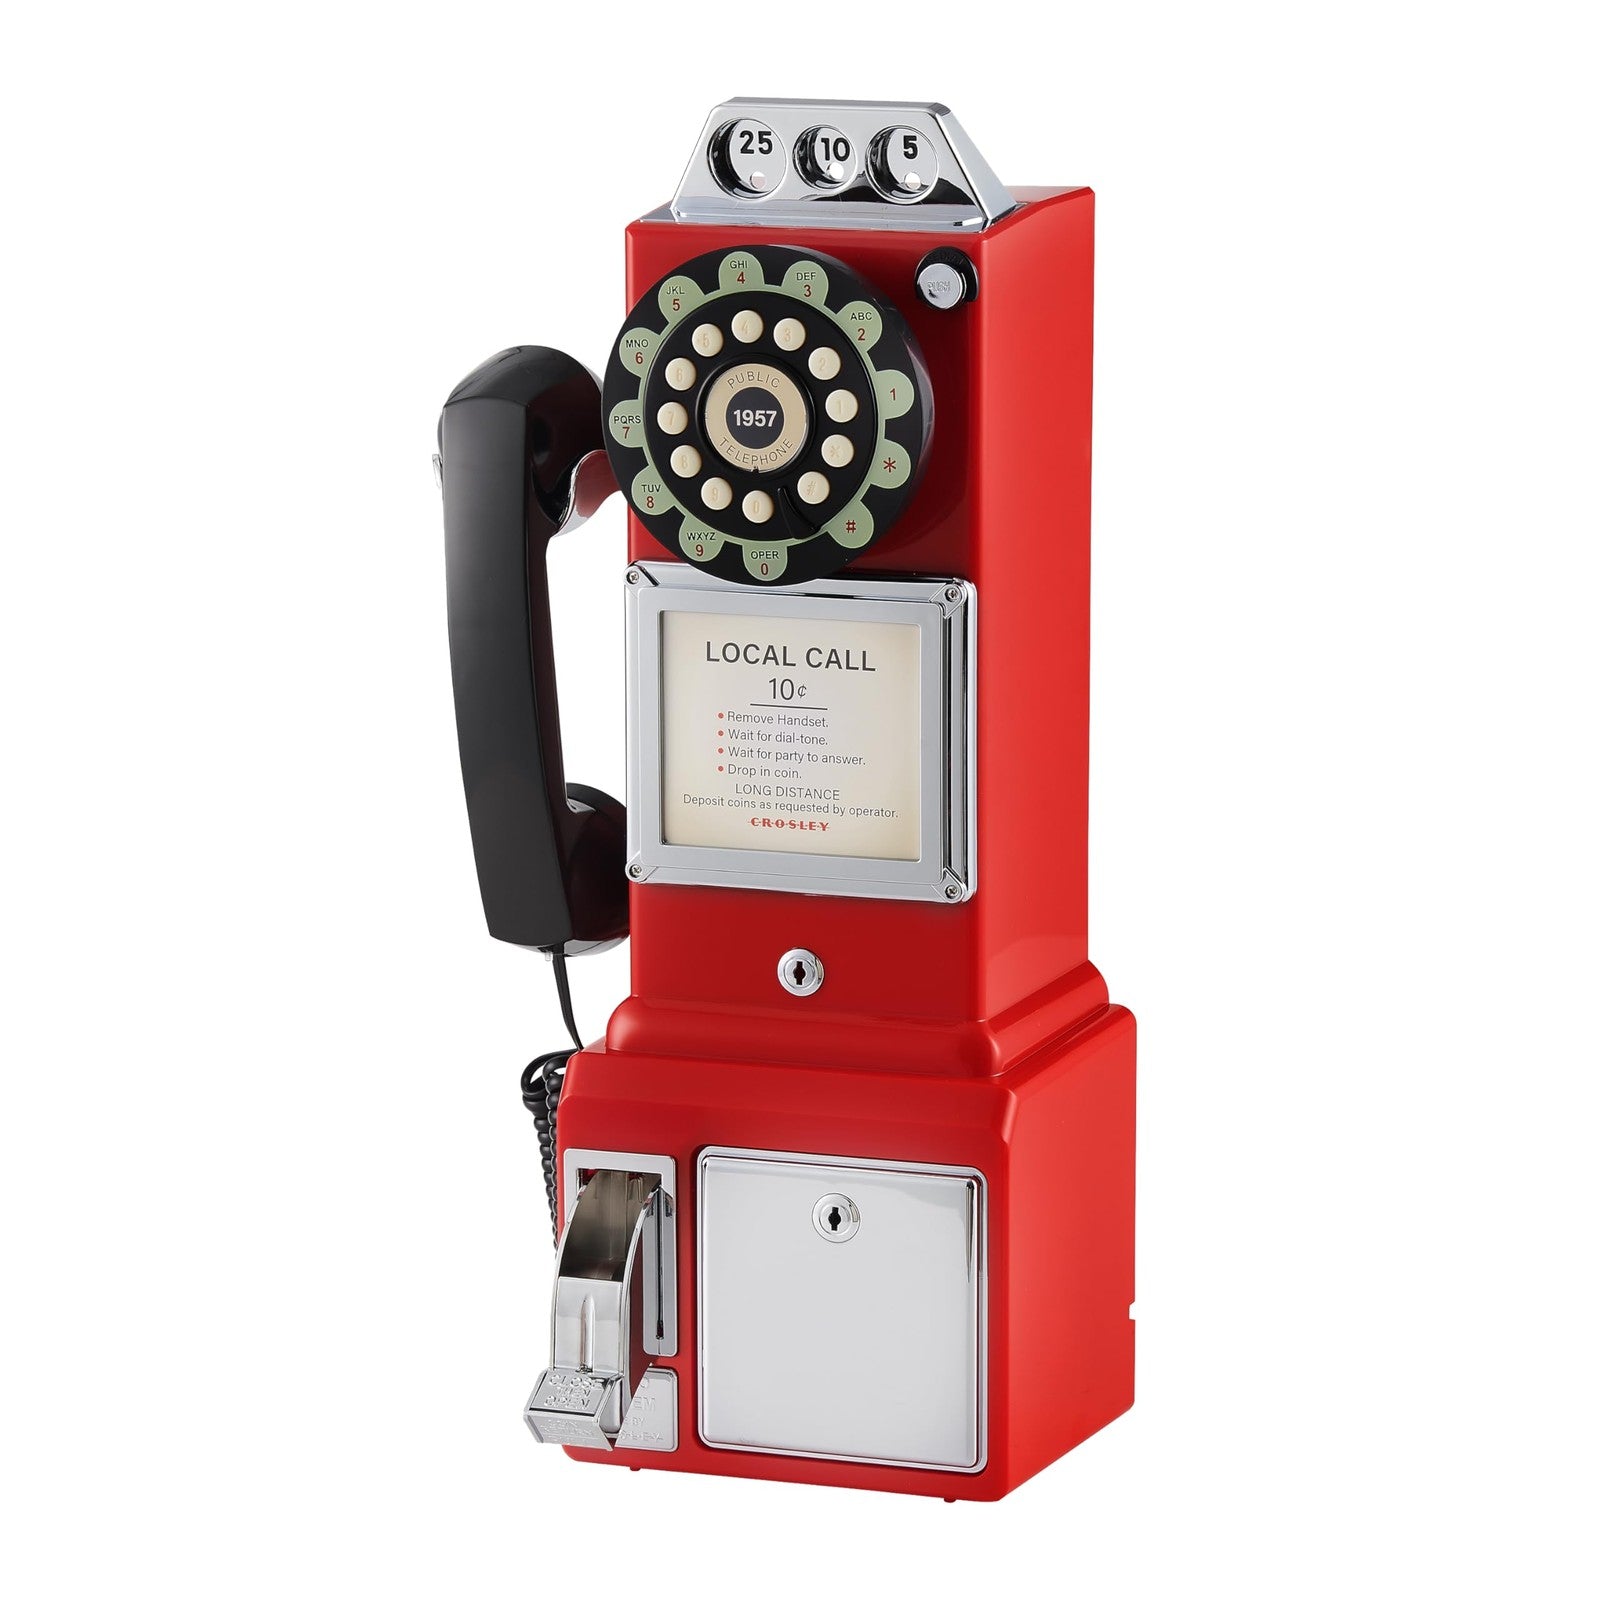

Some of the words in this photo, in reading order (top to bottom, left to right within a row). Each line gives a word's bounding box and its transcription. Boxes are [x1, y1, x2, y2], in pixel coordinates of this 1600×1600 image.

[739, 130, 773, 155] 25
[820, 137, 851, 162] 10
[902, 135, 918, 160] 5
[729, 260, 748, 269] GHI
[736, 271, 746, 285] 4
[796, 271, 816, 281] DEF
[666, 285, 685, 295] JKL
[803, 284, 812, 298] 3
[672, 298, 681, 312] 5
[850, 312, 872, 321] ABC
[857, 327, 866, 341] 2
[625, 339, 649, 348] MNO
[635, 351, 644, 365] 6
[727, 371, 780, 389] PUBLIC
[889, 387, 896, 401] 1
[613, 415, 642, 424] PQRS
[733, 409, 777, 428] 1957
[622, 426, 630, 439] 7
[719, 436, 793, 466] TELEPHONE
[641, 484, 661, 493] TUV
[646, 495, 655, 509] 8
[845, 519, 857, 534] #
[686, 532, 717, 541] WXYZ
[695, 543, 704, 557] 9
[750, 550, 779, 560] OPER
[760, 562, 769, 576] 0
[706, 641, 797, 667] LOCAL
[805, 647, 877, 672] CALL
[727, 711, 774, 725] Remove
[777, 714, 829, 728] Handset.
[728, 728, 754, 741] Wait
[757, 730, 771, 742] for
[775, 731, 828, 746] dial-tone.
[728, 746, 754, 759] Wait
[757, 748, 771, 760] for
[775, 749, 804, 764] party
[807, 752, 819, 763] to
[821, 753, 866, 766] answer.
[727, 764, 757, 778] Drop
[760, 766, 771, 777] in
[774, 767, 802, 779] coin.
[735, 783, 772, 797] LONG
[775, 785, 840, 801] DISTANCE
[683, 794, 725, 807] Deposit
[727, 797, 757, 809] coins
[759, 801, 772, 810] as
[775, 802, 829, 815] requested
[832, 804, 846, 816] by
[849, 806, 899, 818] operator.
[549, 1374, 605, 1391] CLOSE
[544, 1395, 590, 1411] OPEN
